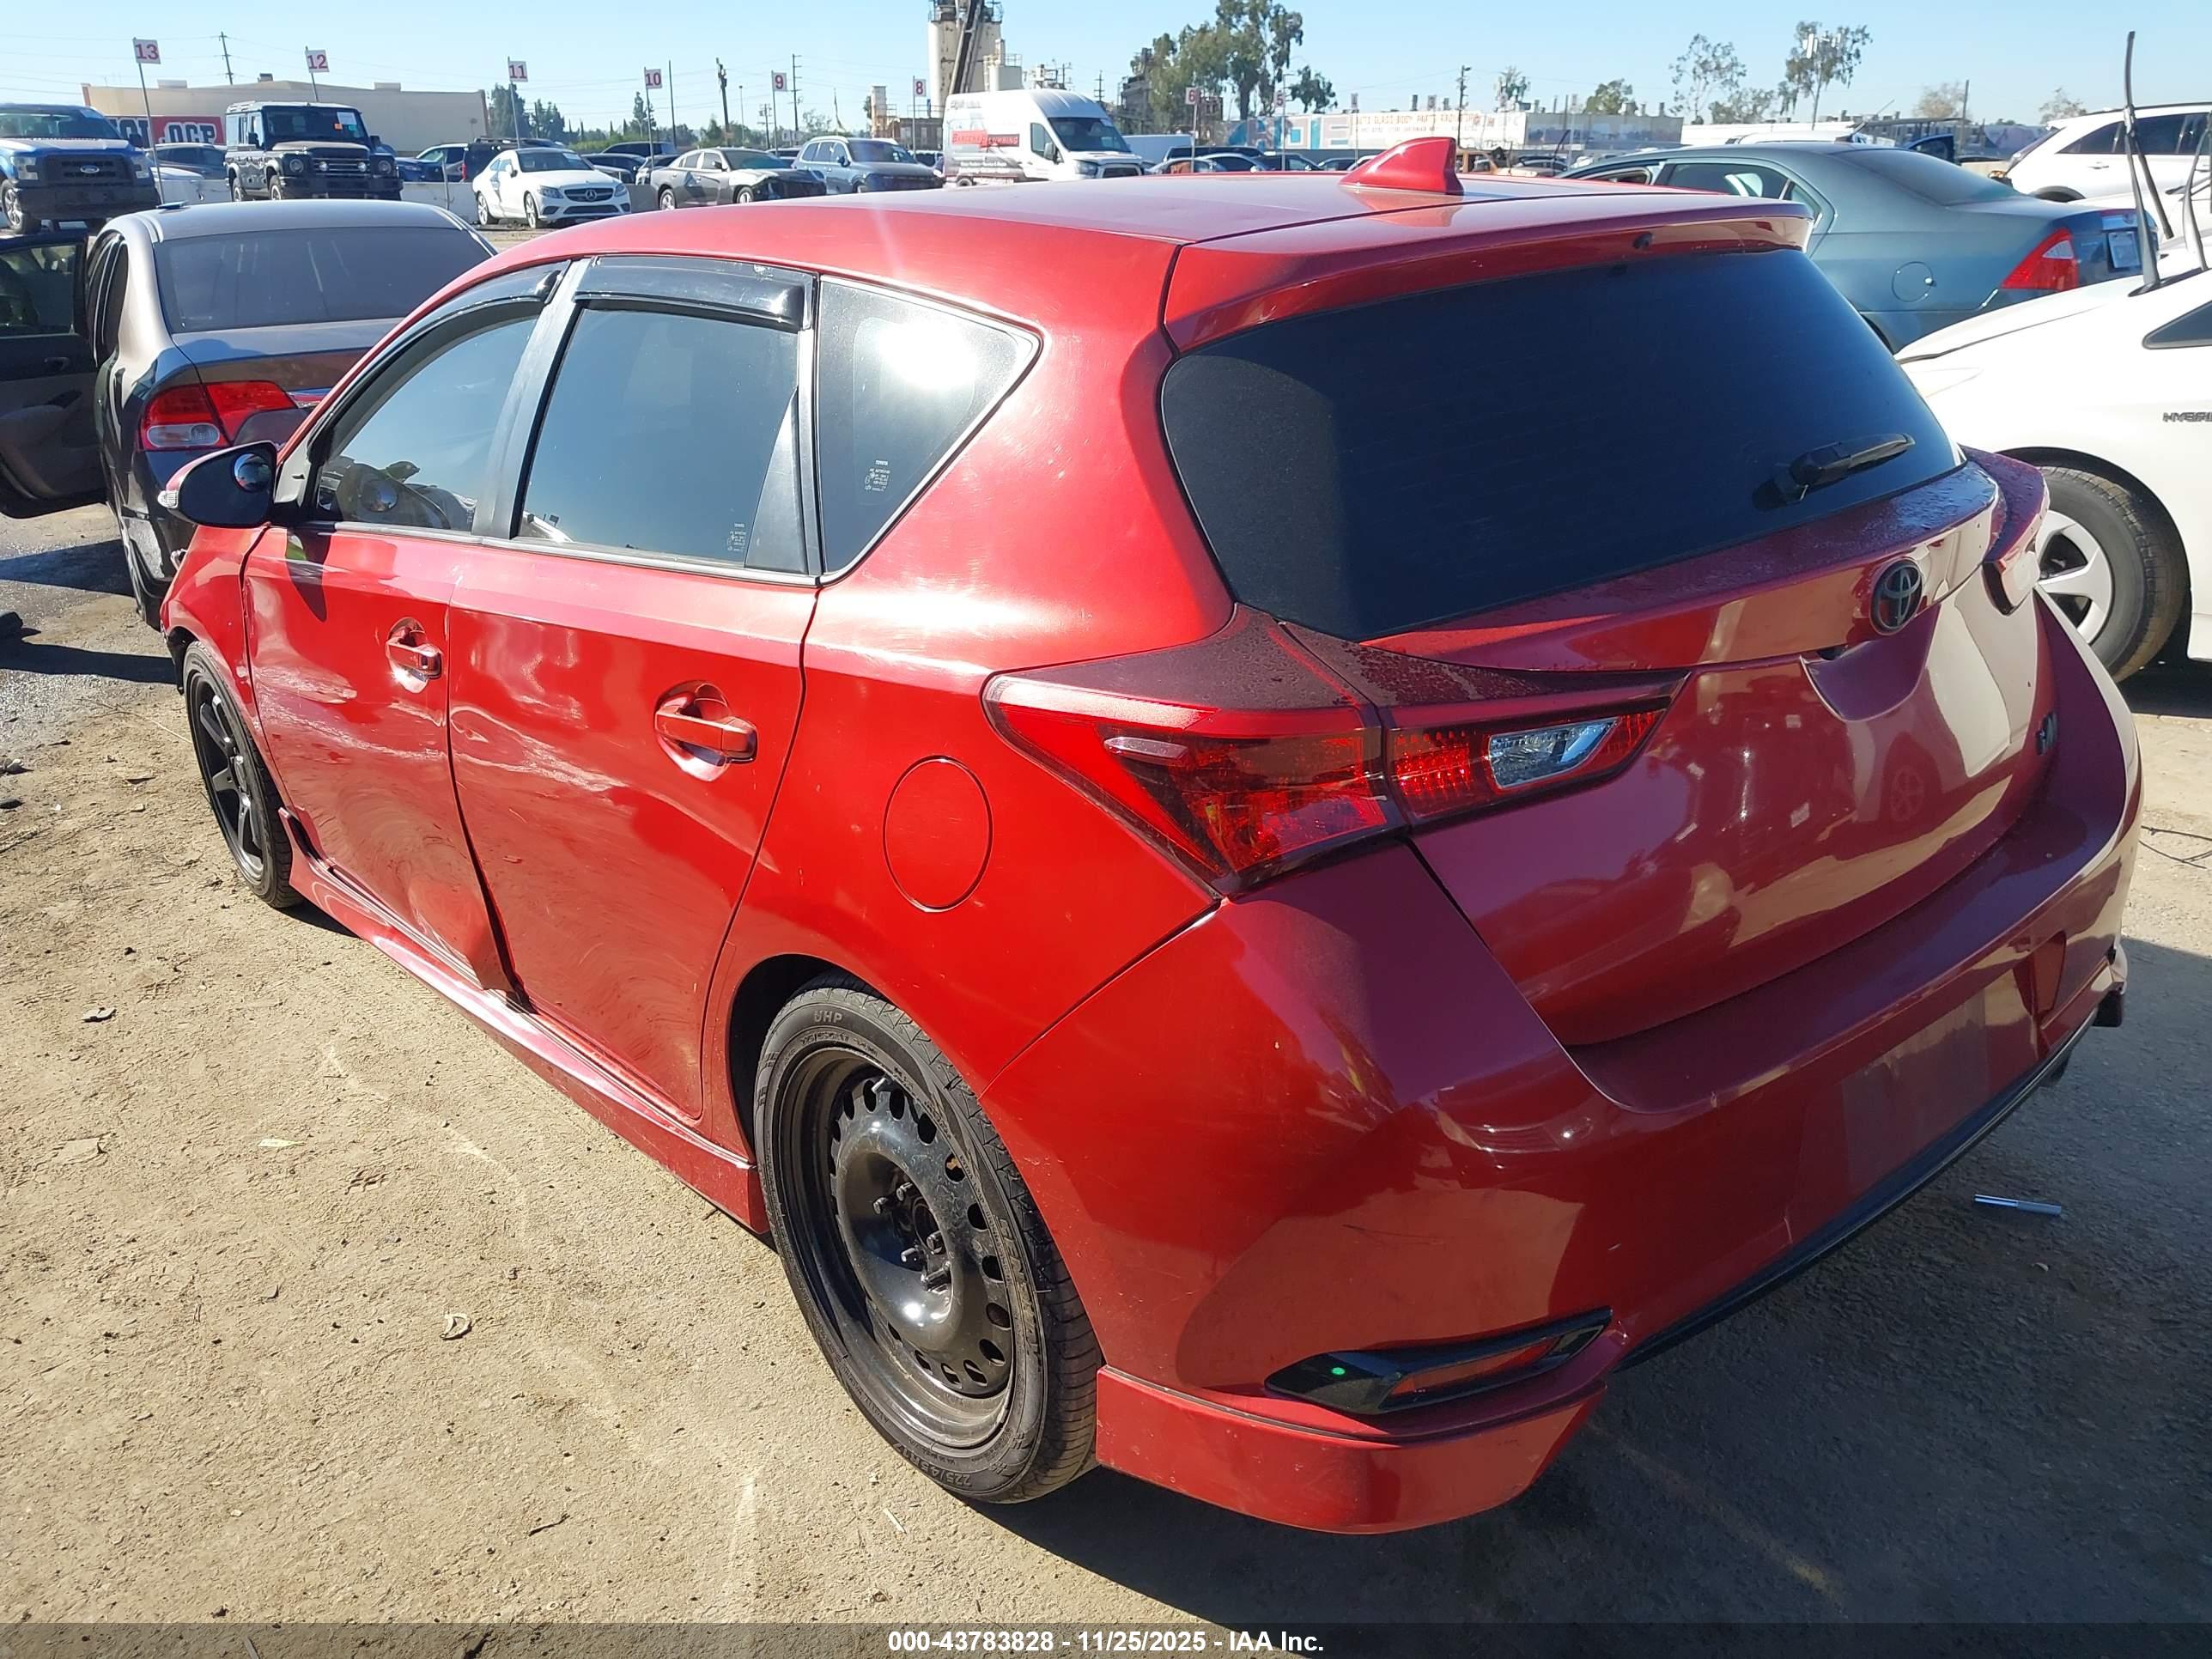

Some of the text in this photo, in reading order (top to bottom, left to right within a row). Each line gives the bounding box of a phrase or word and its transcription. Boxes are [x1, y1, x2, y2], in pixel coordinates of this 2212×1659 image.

[135, 44, 159, 60] 13
[307, 54, 328, 70] 12
[508, 64, 527, 79] 11
[645, 72, 662, 86] 10
[775, 75, 784, 89] 9
[915, 81, 924, 94] 8
[1188, 89, 1196, 102] 6
[1277, 95, 1284, 106] 5
[2163, 412, 2212, 422] HYBRI
[814, 1010, 843, 1024] UHP
[893, 1443, 972, 1487] 225/45R17
